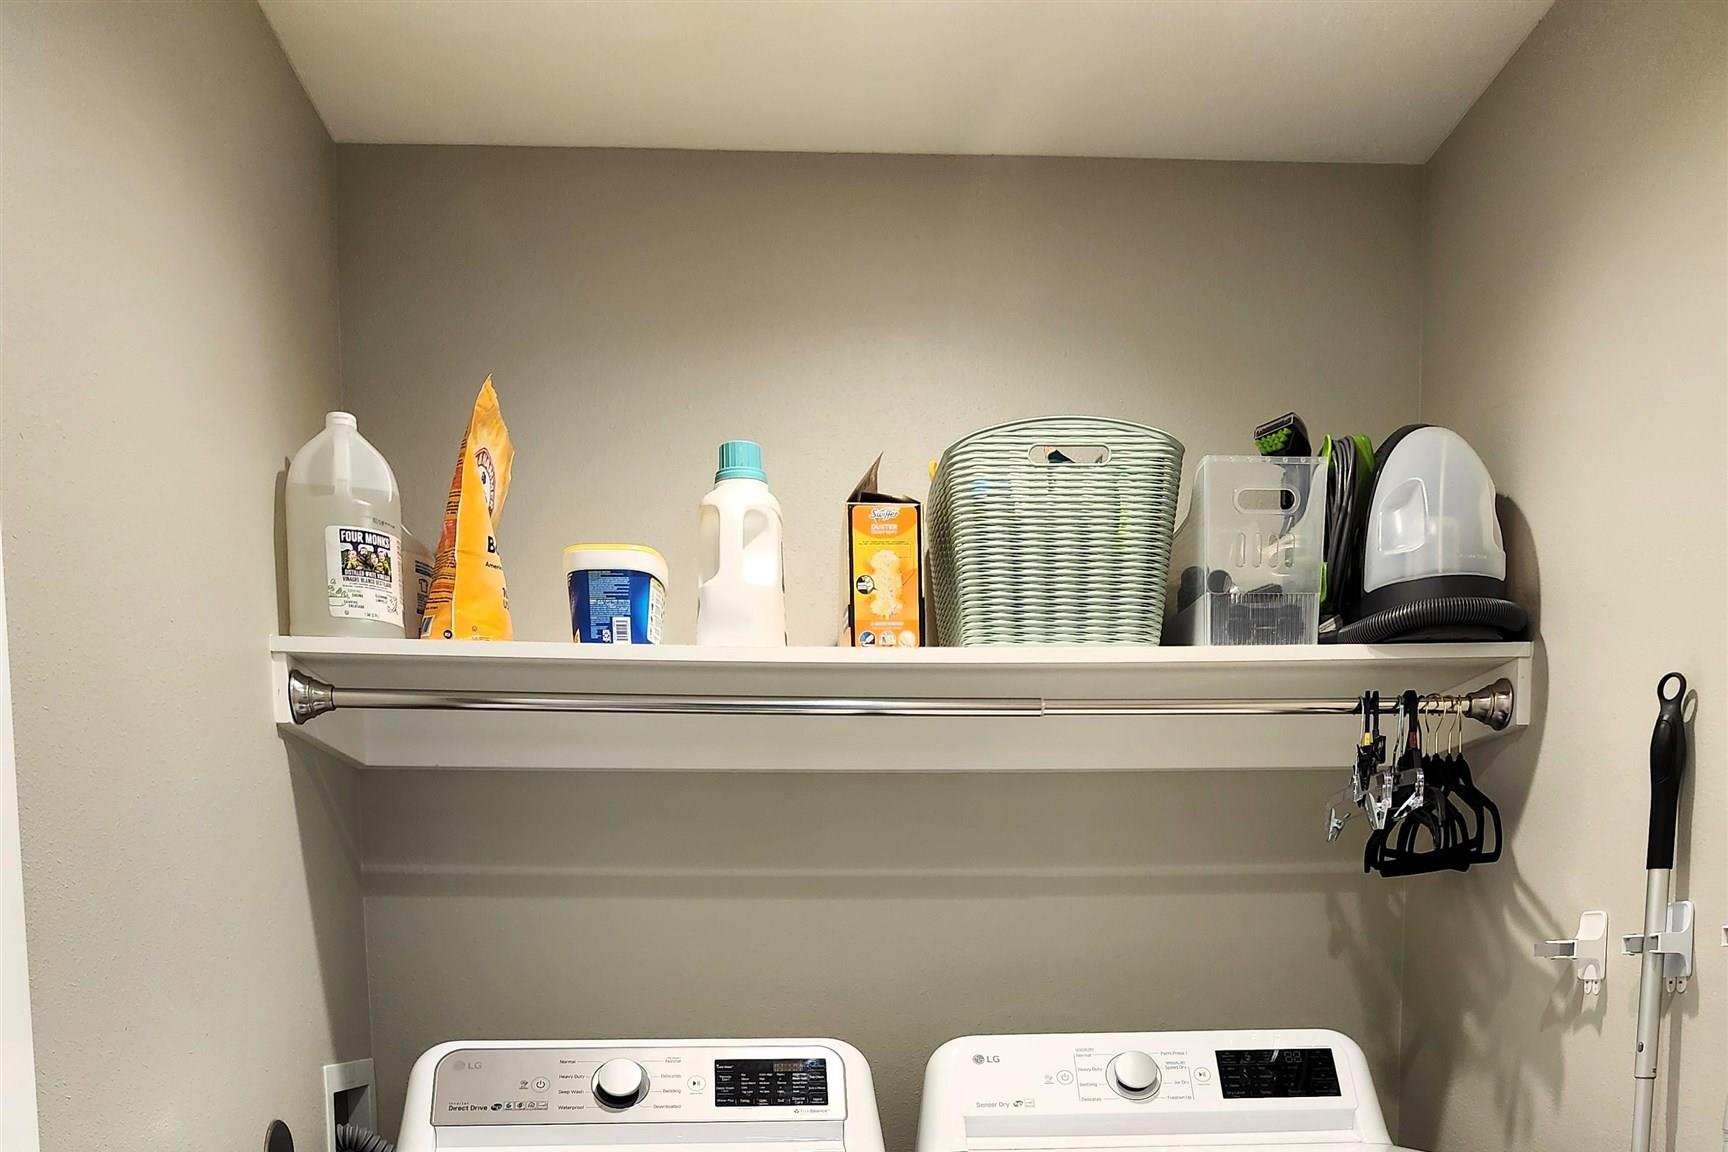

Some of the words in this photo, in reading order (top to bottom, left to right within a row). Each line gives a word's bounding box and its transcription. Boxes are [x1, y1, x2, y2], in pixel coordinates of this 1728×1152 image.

[871, 509, 898, 521] Swiffer
[341, 530, 363, 543] FOUR
[365, 533, 390, 549] MONKS
[986, 1055, 1001, 1063] LG
[467, 1062, 482, 1070] LG
